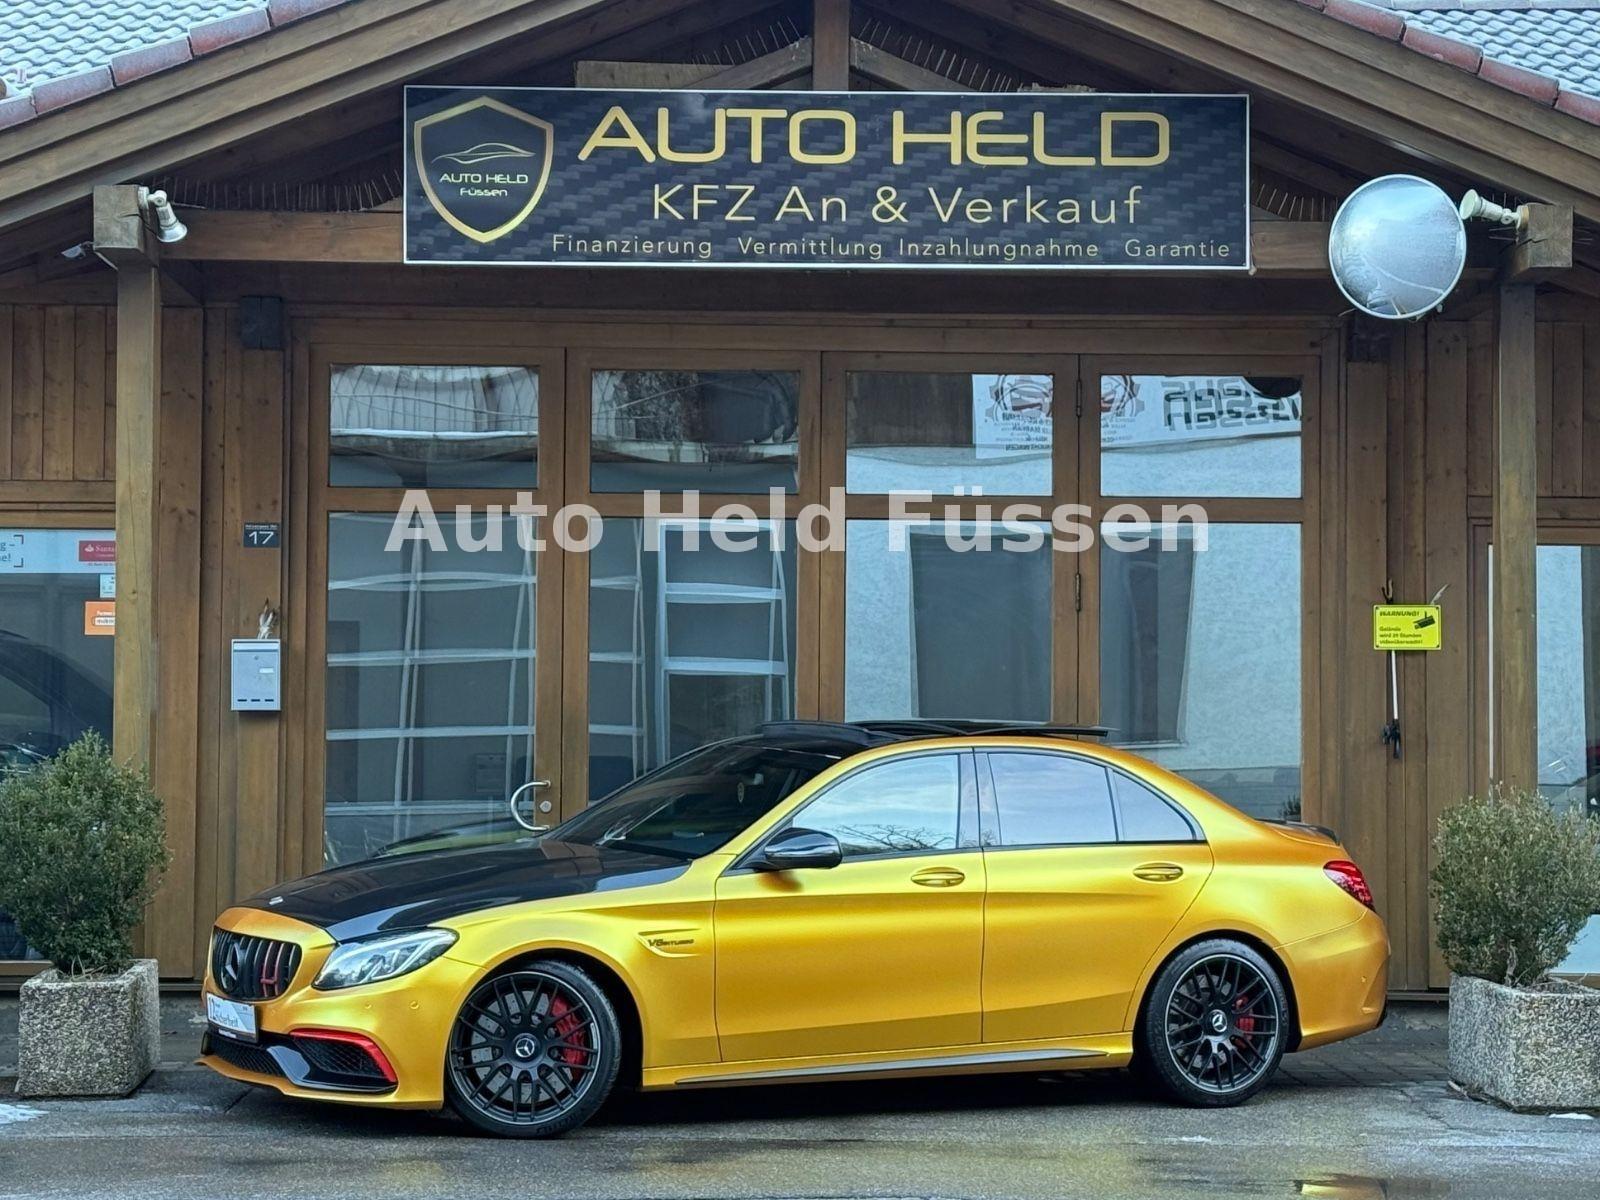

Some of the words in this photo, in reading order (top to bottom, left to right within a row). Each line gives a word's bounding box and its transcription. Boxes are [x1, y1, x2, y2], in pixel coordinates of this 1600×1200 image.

[577, 105, 857, 165] AUTO
[891, 110, 1171, 167] HELD
[439, 173, 482, 184] AUTO
[485, 174, 529, 185] HELD
[459, 187, 509, 197] Füssen
[652, 184, 756, 222] KFZ
[774, 186, 847, 223] An
[871, 185, 910, 224] &
[928, 185, 1143, 225] Verkauf
[552, 234, 713, 259] Finanzierung
[737, 236, 883, 261] Vermittlung
[899, 237, 1099, 261] Inzahlungnahme
[1124, 239, 1231, 259] Garantie
[248, 531, 275, 545] 17
